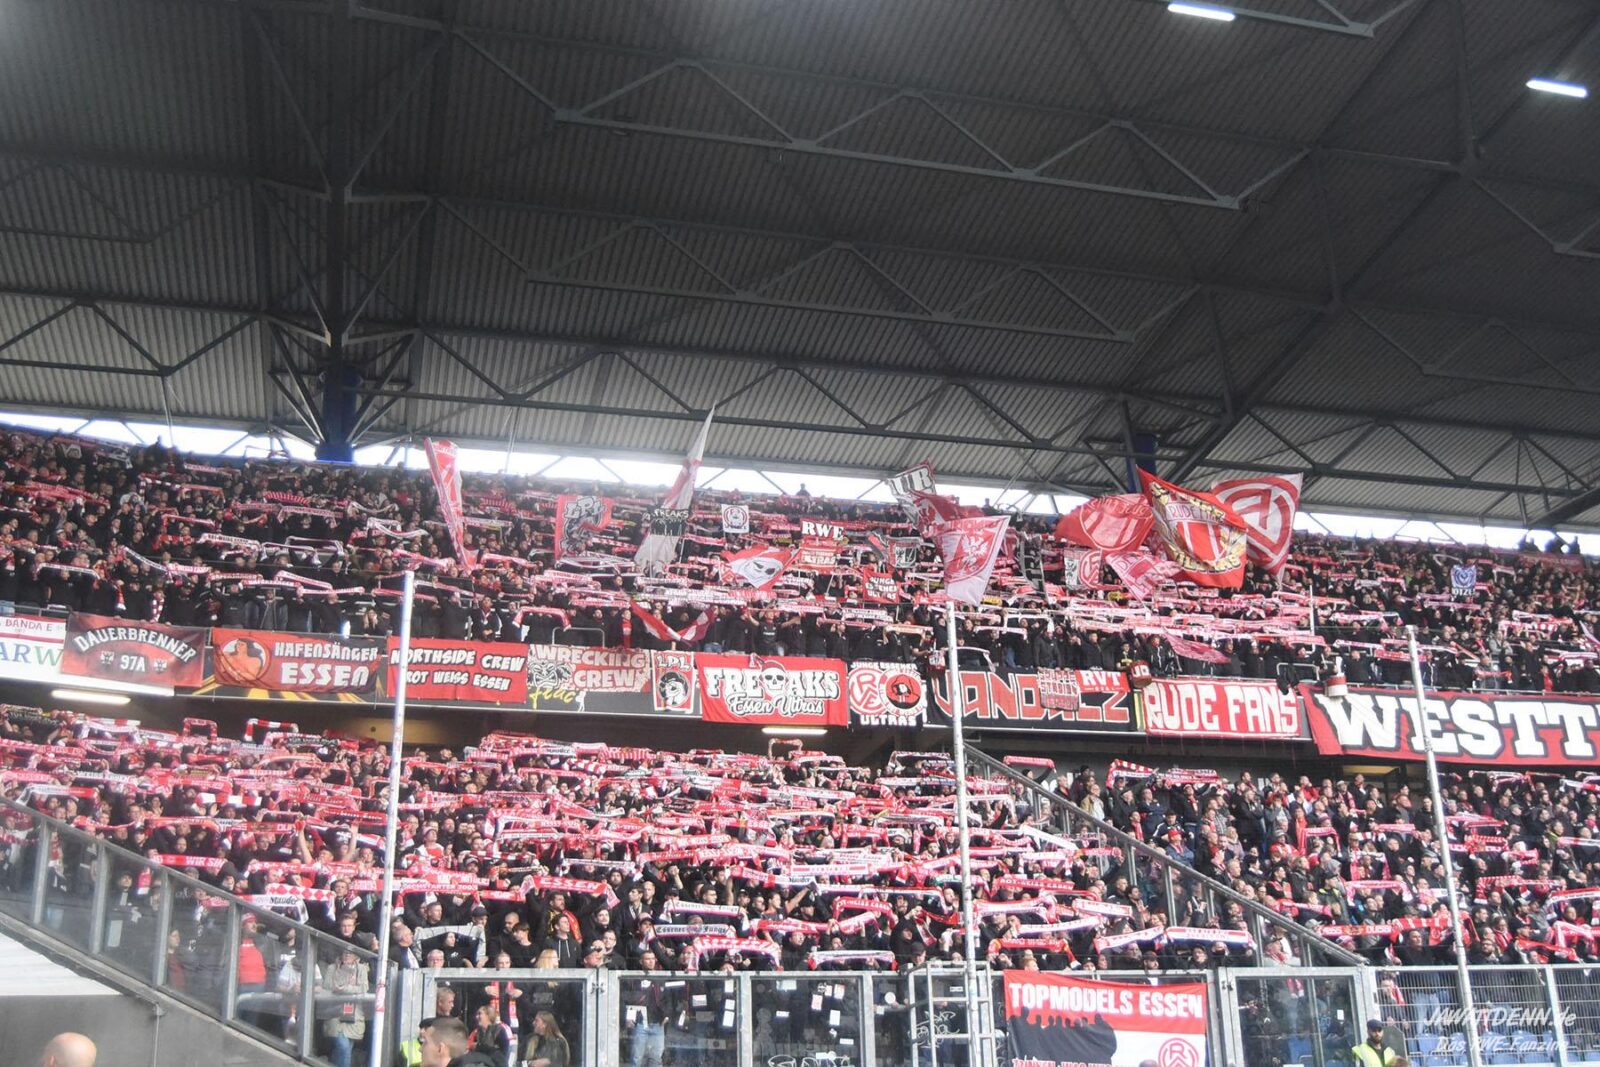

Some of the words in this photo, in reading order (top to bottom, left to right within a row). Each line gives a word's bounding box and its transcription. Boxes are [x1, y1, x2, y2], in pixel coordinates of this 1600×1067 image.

[801, 521, 844, 540] RWE
[5, 619, 42, 630] BANDA
[74, 627, 197, 663] DAUERBRENNER
[274, 641, 379, 662] HAFENSÄNGER
[119, 655, 146, 672] 97A
[481, 654, 525, 673] CREW
[535, 645, 645, 669] WRECKING
[280, 663, 370, 687] ESSEN
[433, 671, 469, 686] WEISS
[473, 676, 511, 691] ESSEN
[574, 669, 635, 688] CREW
[1081, 670, 1121, 687] RVT
[727, 692, 773, 716] Essen
[774, 696, 825, 717] Ultras
[1147, 685, 1219, 732] RUDE
[1228, 685, 1299, 734] FANS
[860, 715, 917, 727] ULTRAS
[1314, 693, 1600, 756] WESTT
[186, 856, 206, 866] WIR
[540, 876, 601, 890] ESSEN
[1009, 983, 1134, 1016] TOPMODELS
[1139, 990, 1204, 1018] ESSEN
